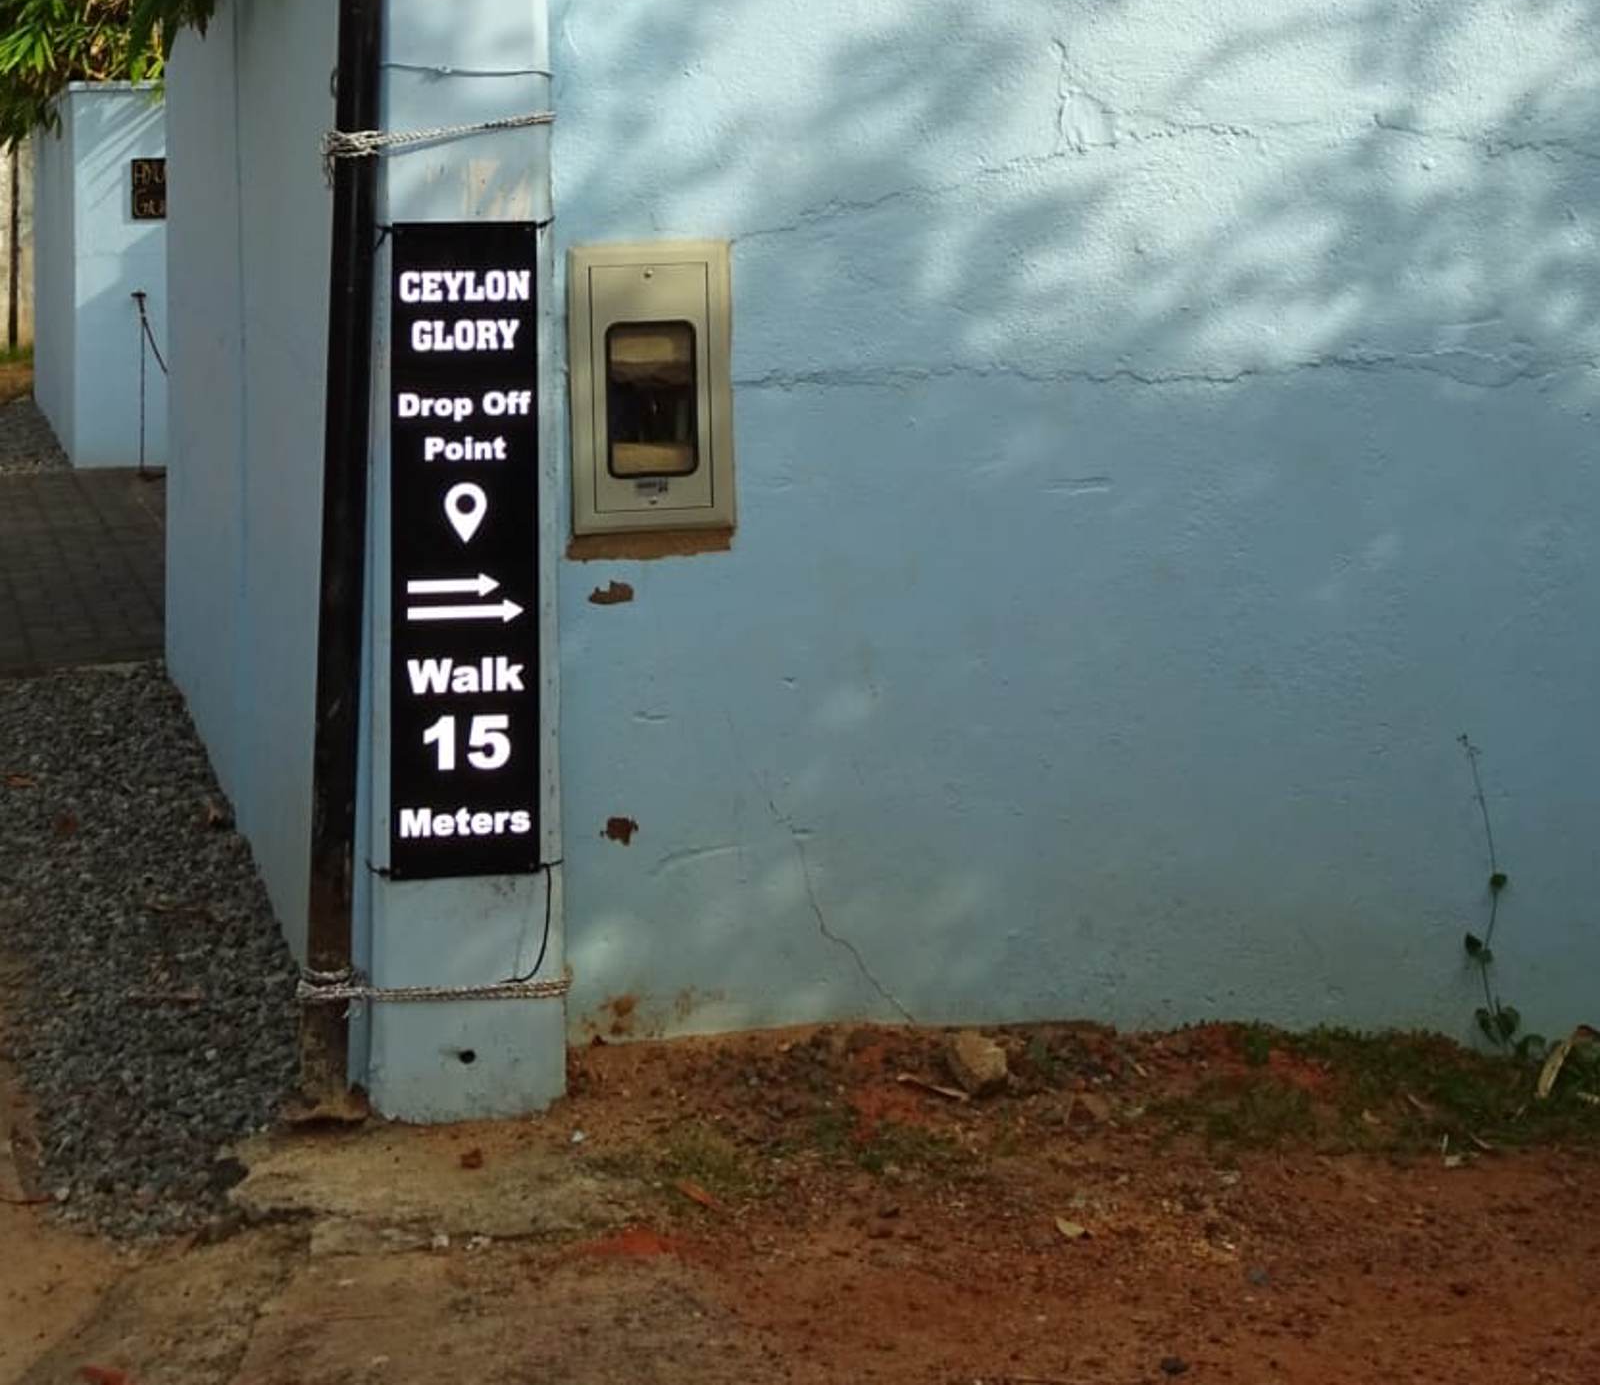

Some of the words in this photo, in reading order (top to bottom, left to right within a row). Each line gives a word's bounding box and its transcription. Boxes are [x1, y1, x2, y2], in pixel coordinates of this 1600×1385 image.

[399, 270, 531, 303] CEYLON
[411, 318, 520, 352] GLORY
[398, 392, 474, 423] Drop
[482, 390, 532, 416] Off
[424, 435, 507, 461] Point
[407, 656, 525, 695] Walk
[423, 714, 511, 771] 15
[400, 807, 531, 838] Meters
